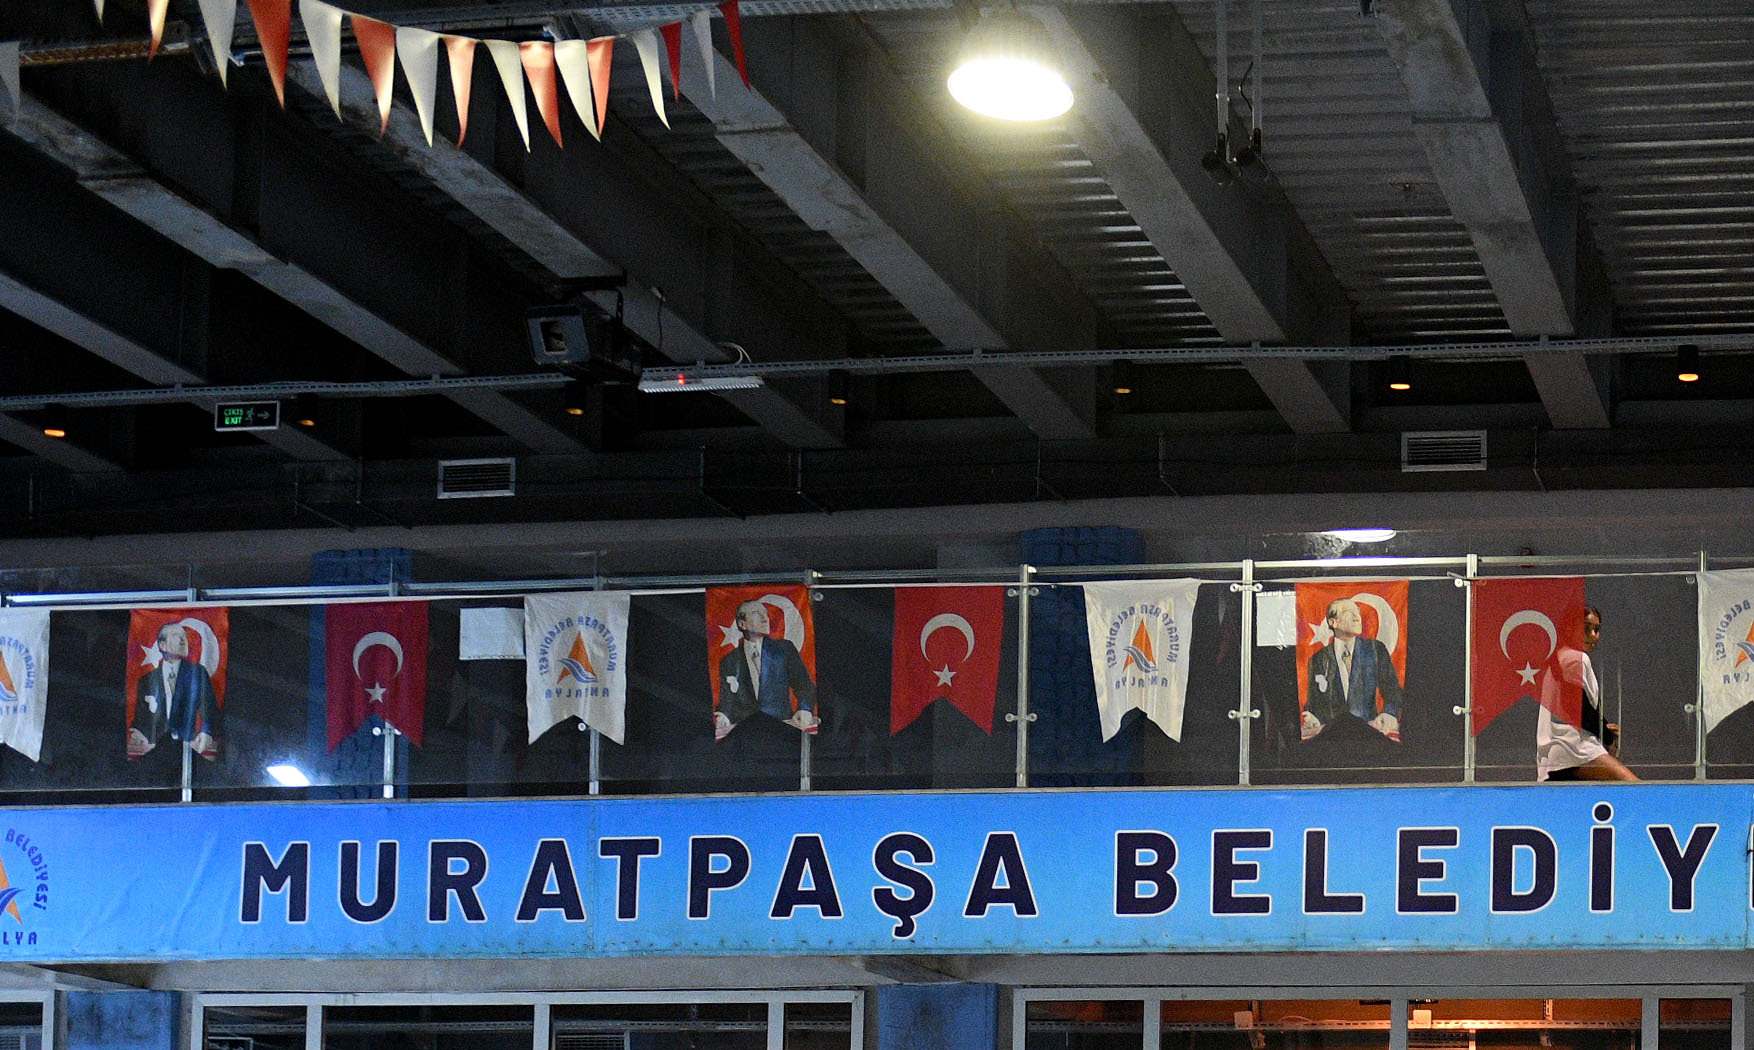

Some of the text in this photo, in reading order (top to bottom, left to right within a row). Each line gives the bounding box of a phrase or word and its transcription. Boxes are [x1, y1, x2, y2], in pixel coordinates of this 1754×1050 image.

[225, 417, 242, 425] EXIT
[5, 828, 48, 910] BELEDİYESİ
[239, 832, 1039, 940] MURATPAŞA
